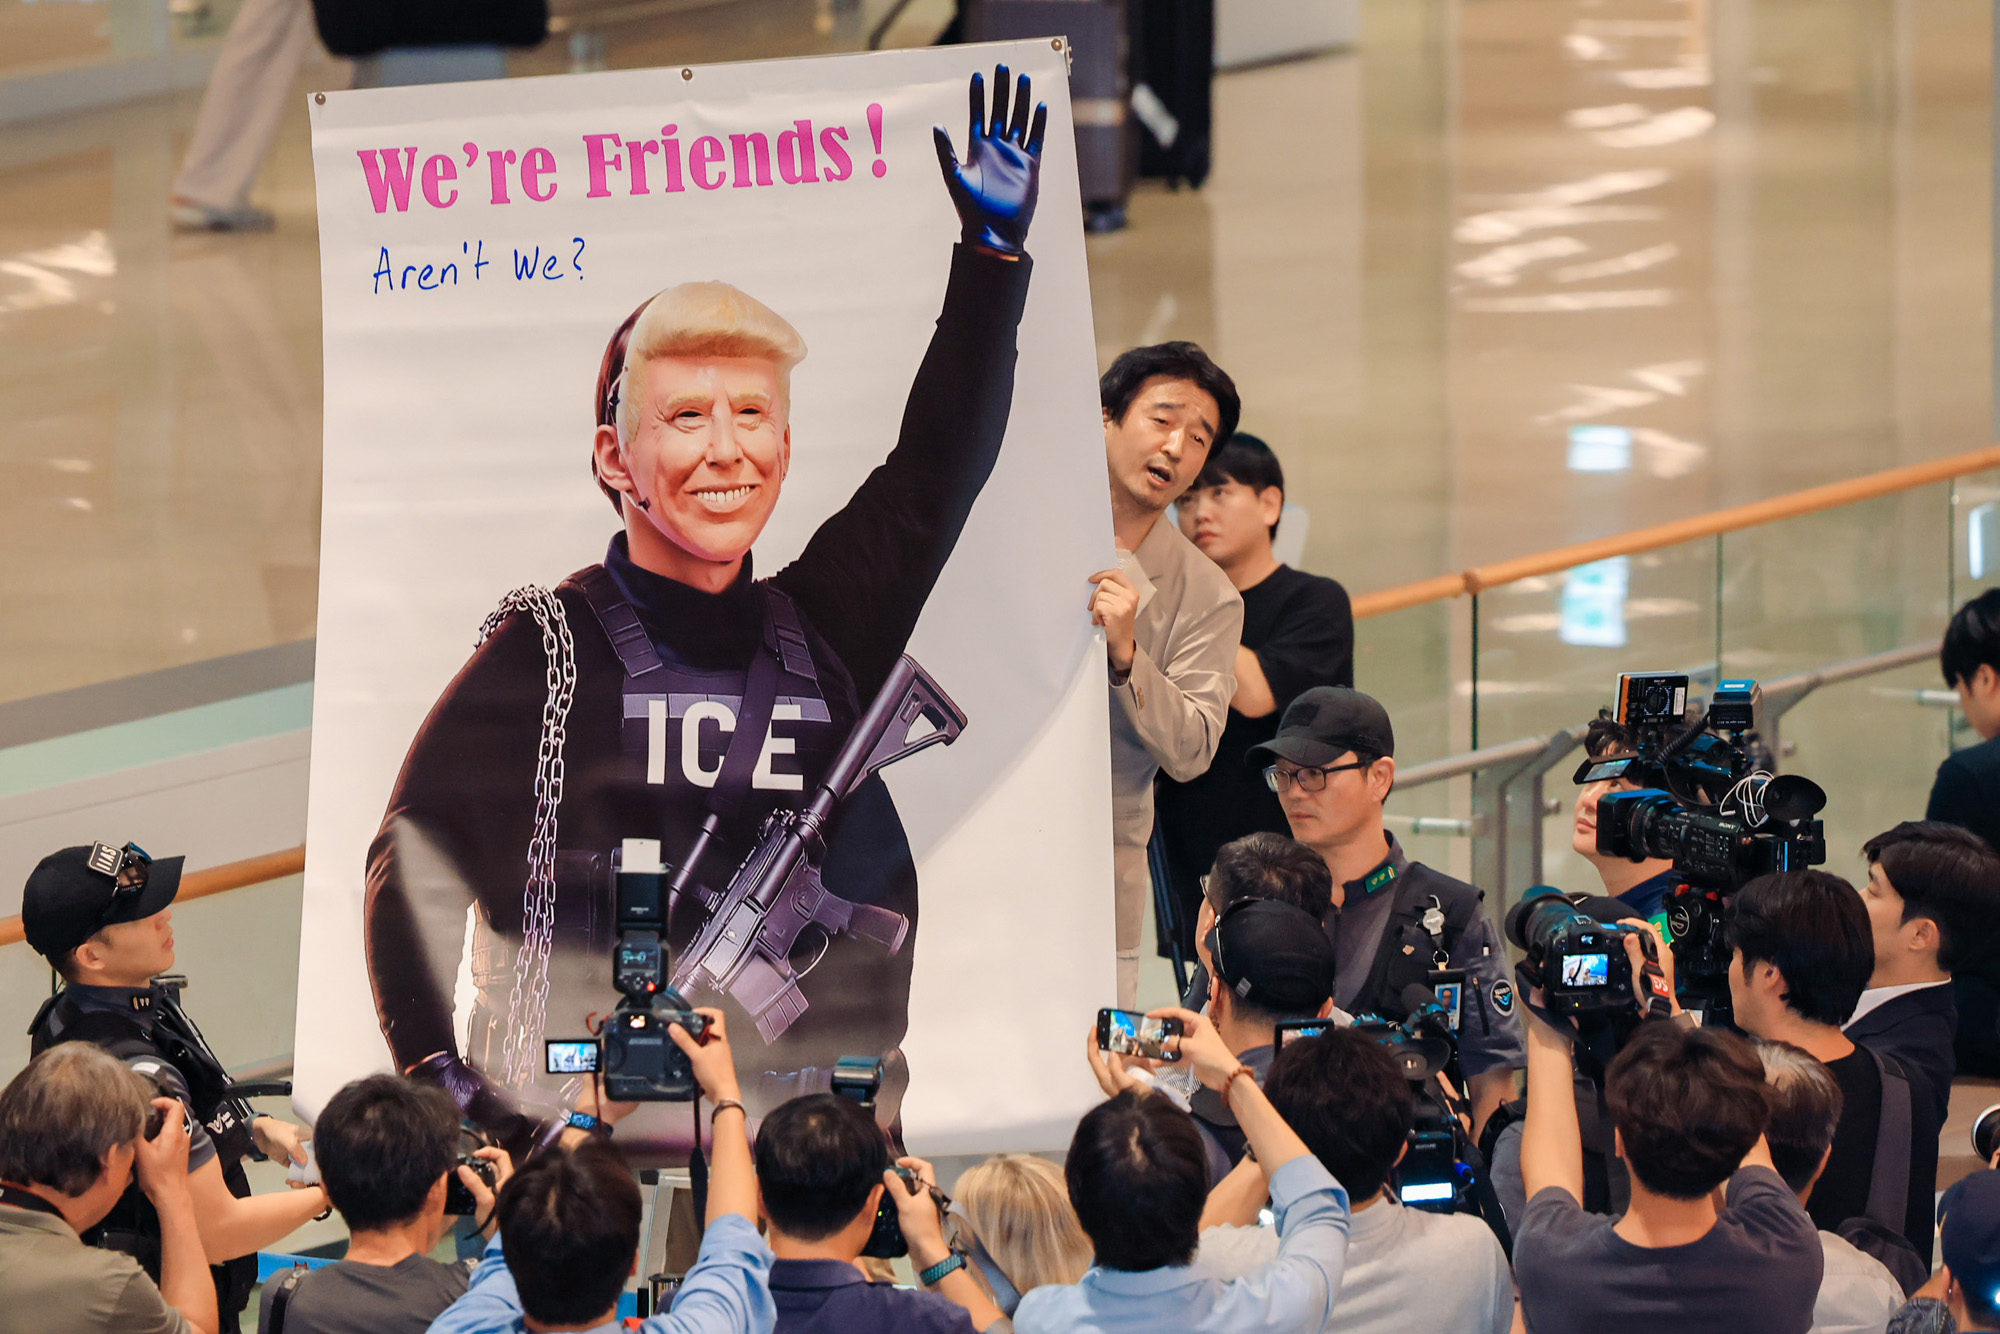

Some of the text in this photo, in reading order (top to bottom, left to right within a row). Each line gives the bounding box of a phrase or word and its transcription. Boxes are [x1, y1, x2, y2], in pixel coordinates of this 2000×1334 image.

[357, 143, 557, 214] We're
[374, 237, 585, 294] Aren't We?
[647, 699, 804, 790] ICE
